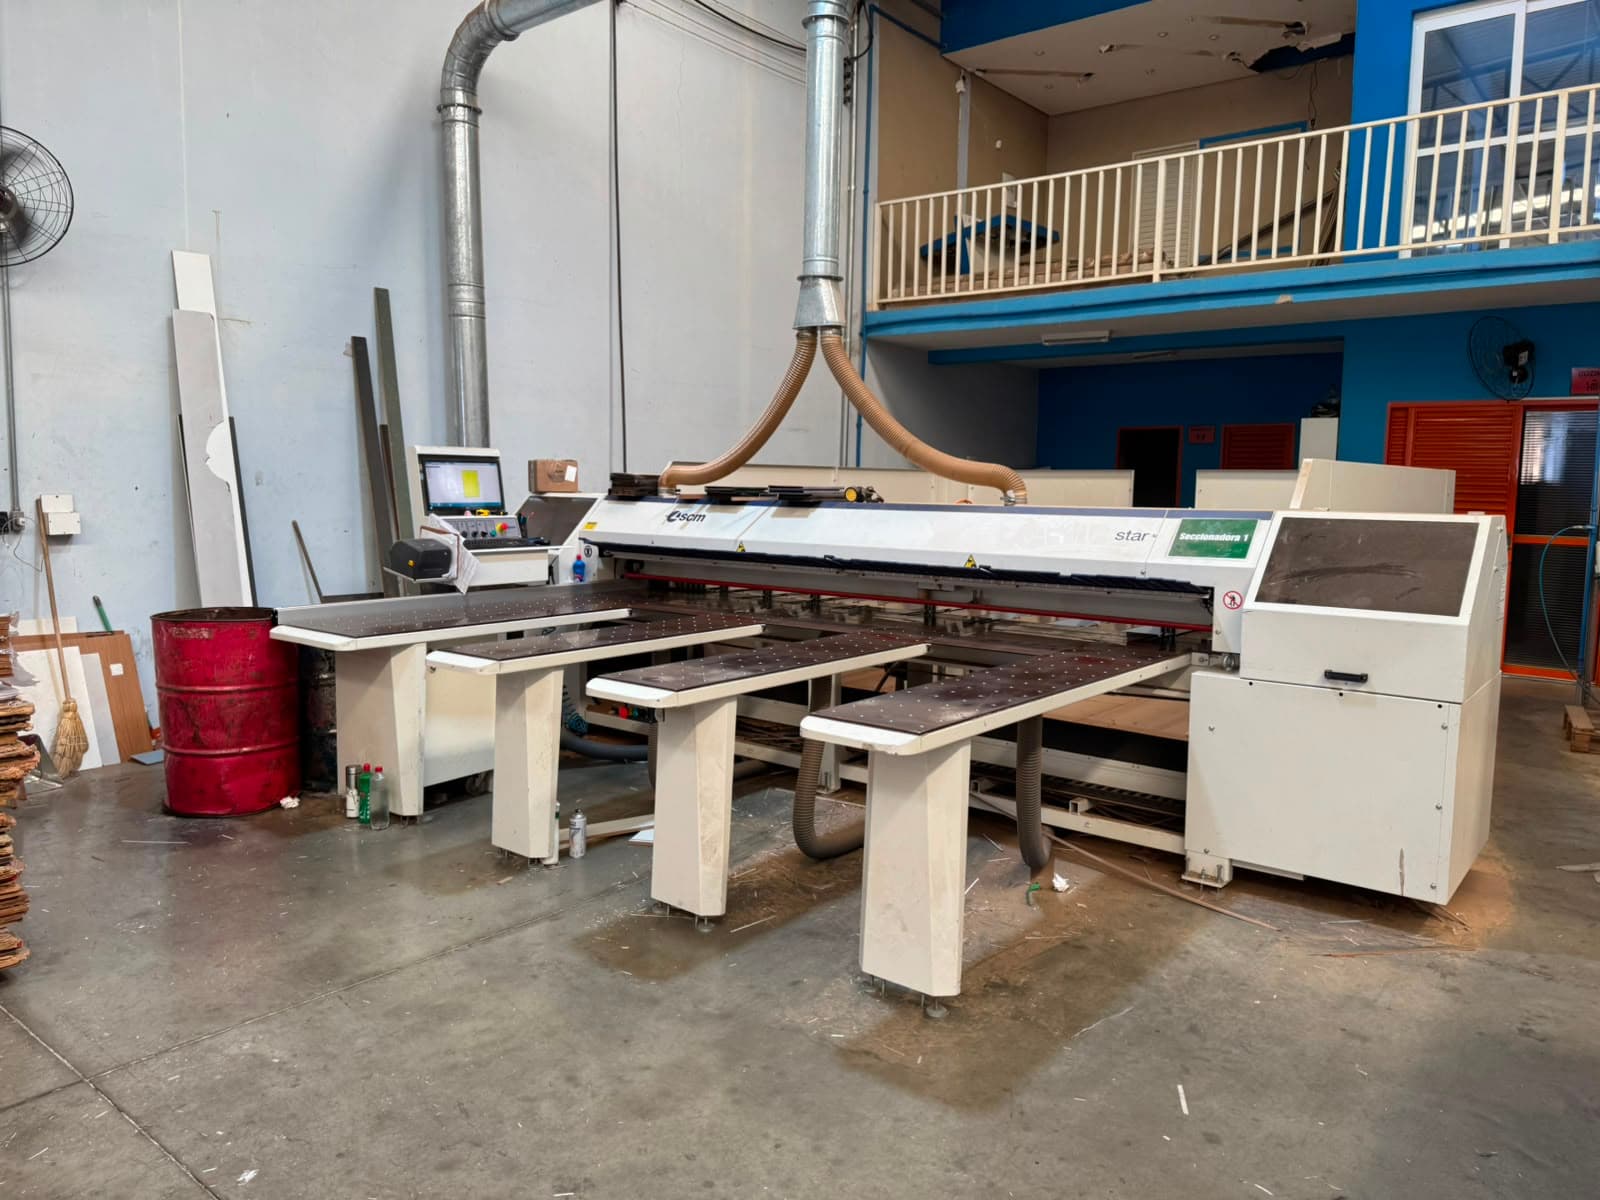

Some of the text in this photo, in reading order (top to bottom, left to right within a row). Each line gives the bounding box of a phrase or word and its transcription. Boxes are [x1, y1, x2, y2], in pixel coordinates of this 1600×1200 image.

[679, 511, 706, 522] scm
[1114, 529, 1150, 542] star
[1179, 532, 1249, 542] Seccionadora 1
